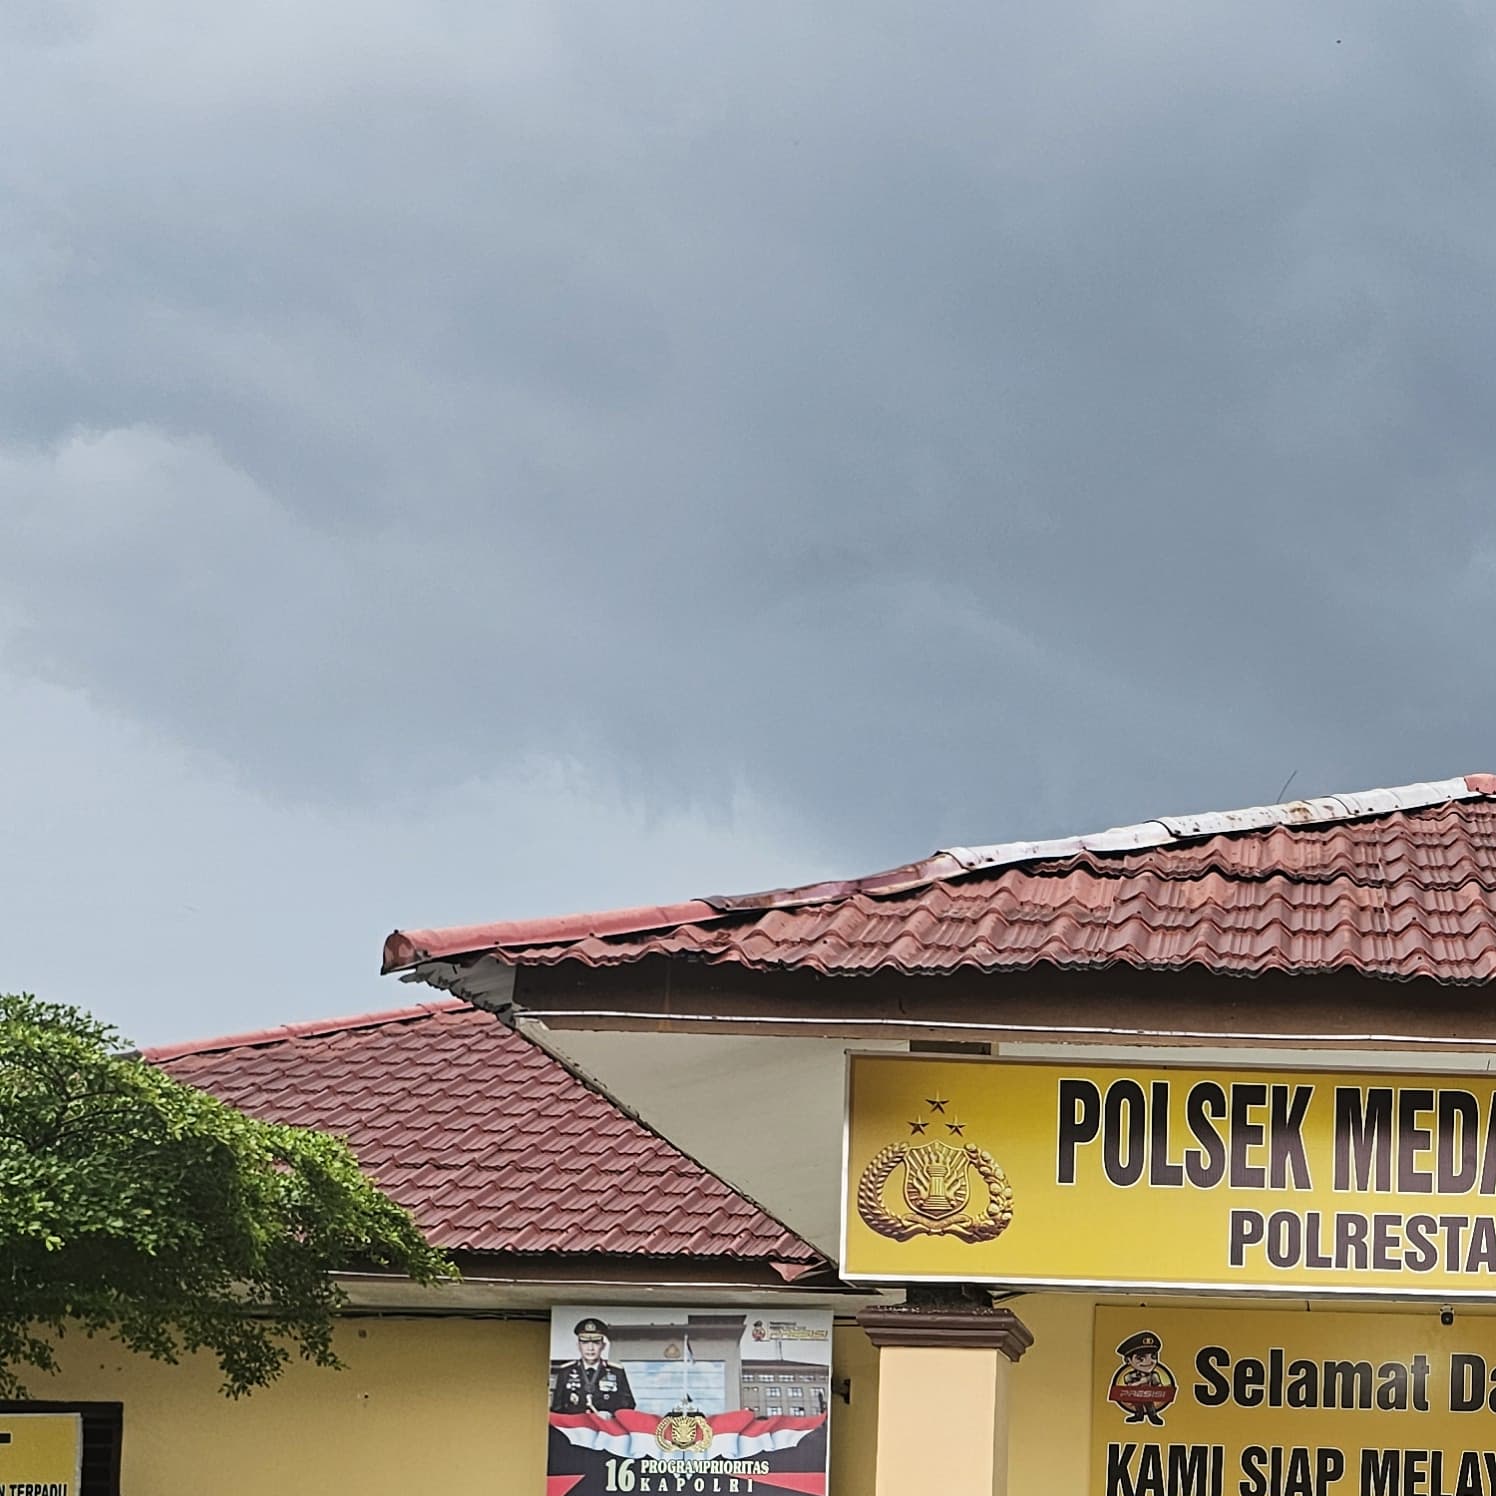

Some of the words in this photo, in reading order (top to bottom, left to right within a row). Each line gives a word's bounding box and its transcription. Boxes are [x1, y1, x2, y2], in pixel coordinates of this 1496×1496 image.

[1058, 1078, 1314, 1190] POLSEK
[1194, 1346, 1430, 1412] Selamat
[605, 1458, 635, 1492] 16
[640, 1478, 753, 1492] KAPOLRI
